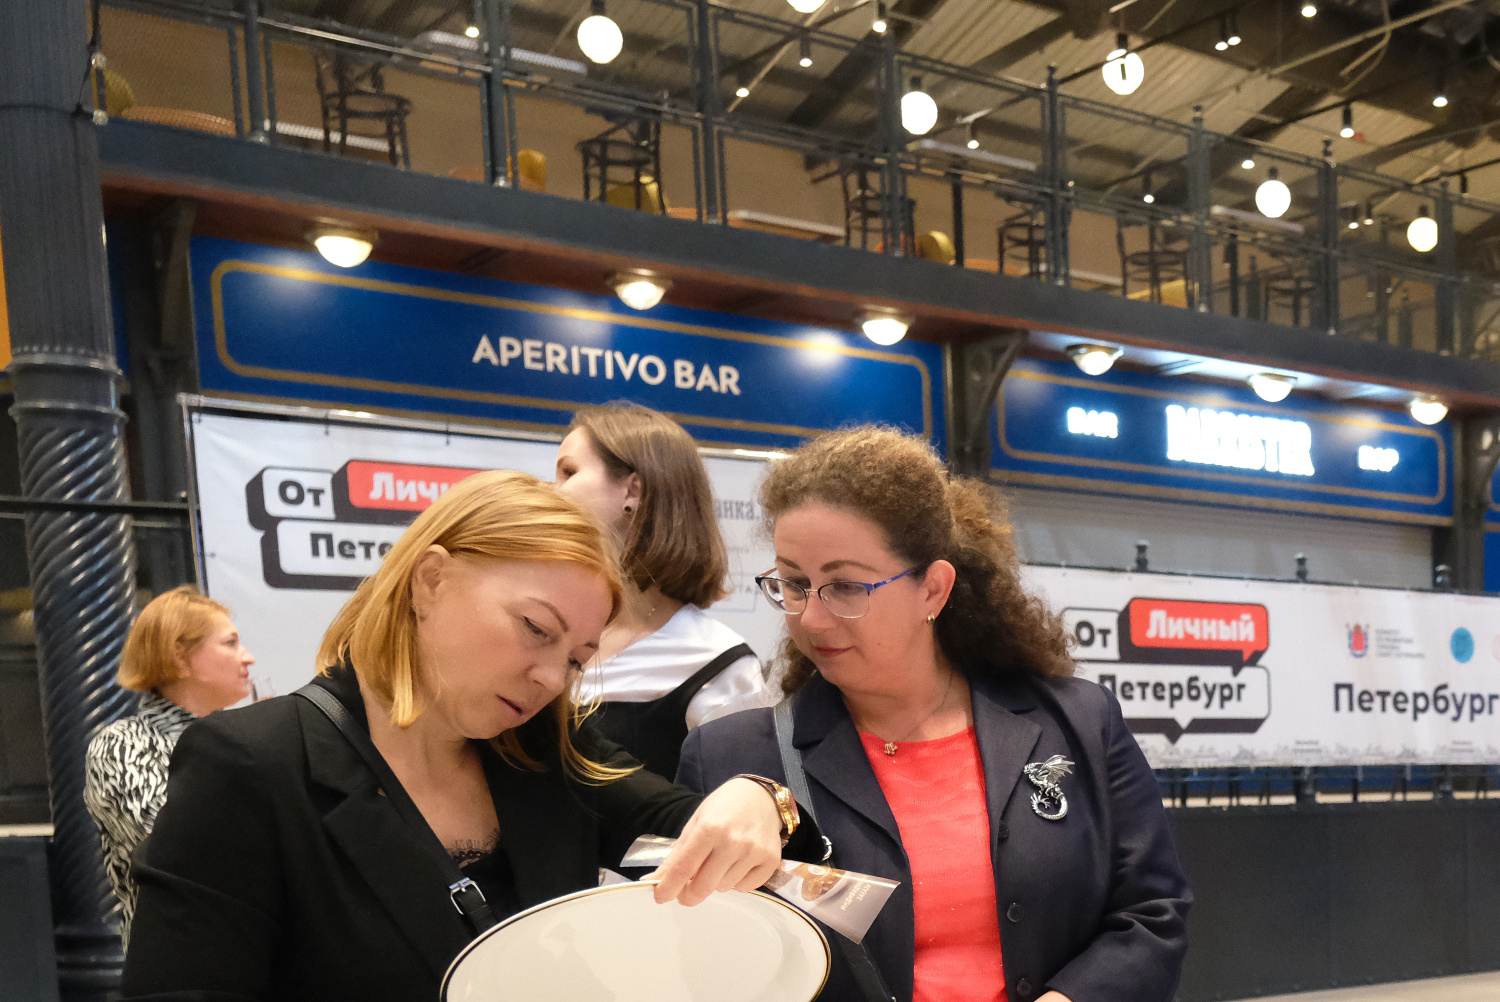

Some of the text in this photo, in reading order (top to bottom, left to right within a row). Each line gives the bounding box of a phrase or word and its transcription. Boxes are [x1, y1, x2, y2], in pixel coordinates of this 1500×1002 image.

[472, 334, 742, 397] APERITIVO BAR
[278, 479, 326, 507] От
[1075, 609, 1256, 648] От Личный
[1098, 674, 1246, 709] Петербург
[1332, 682, 1500, 723] Петербург
